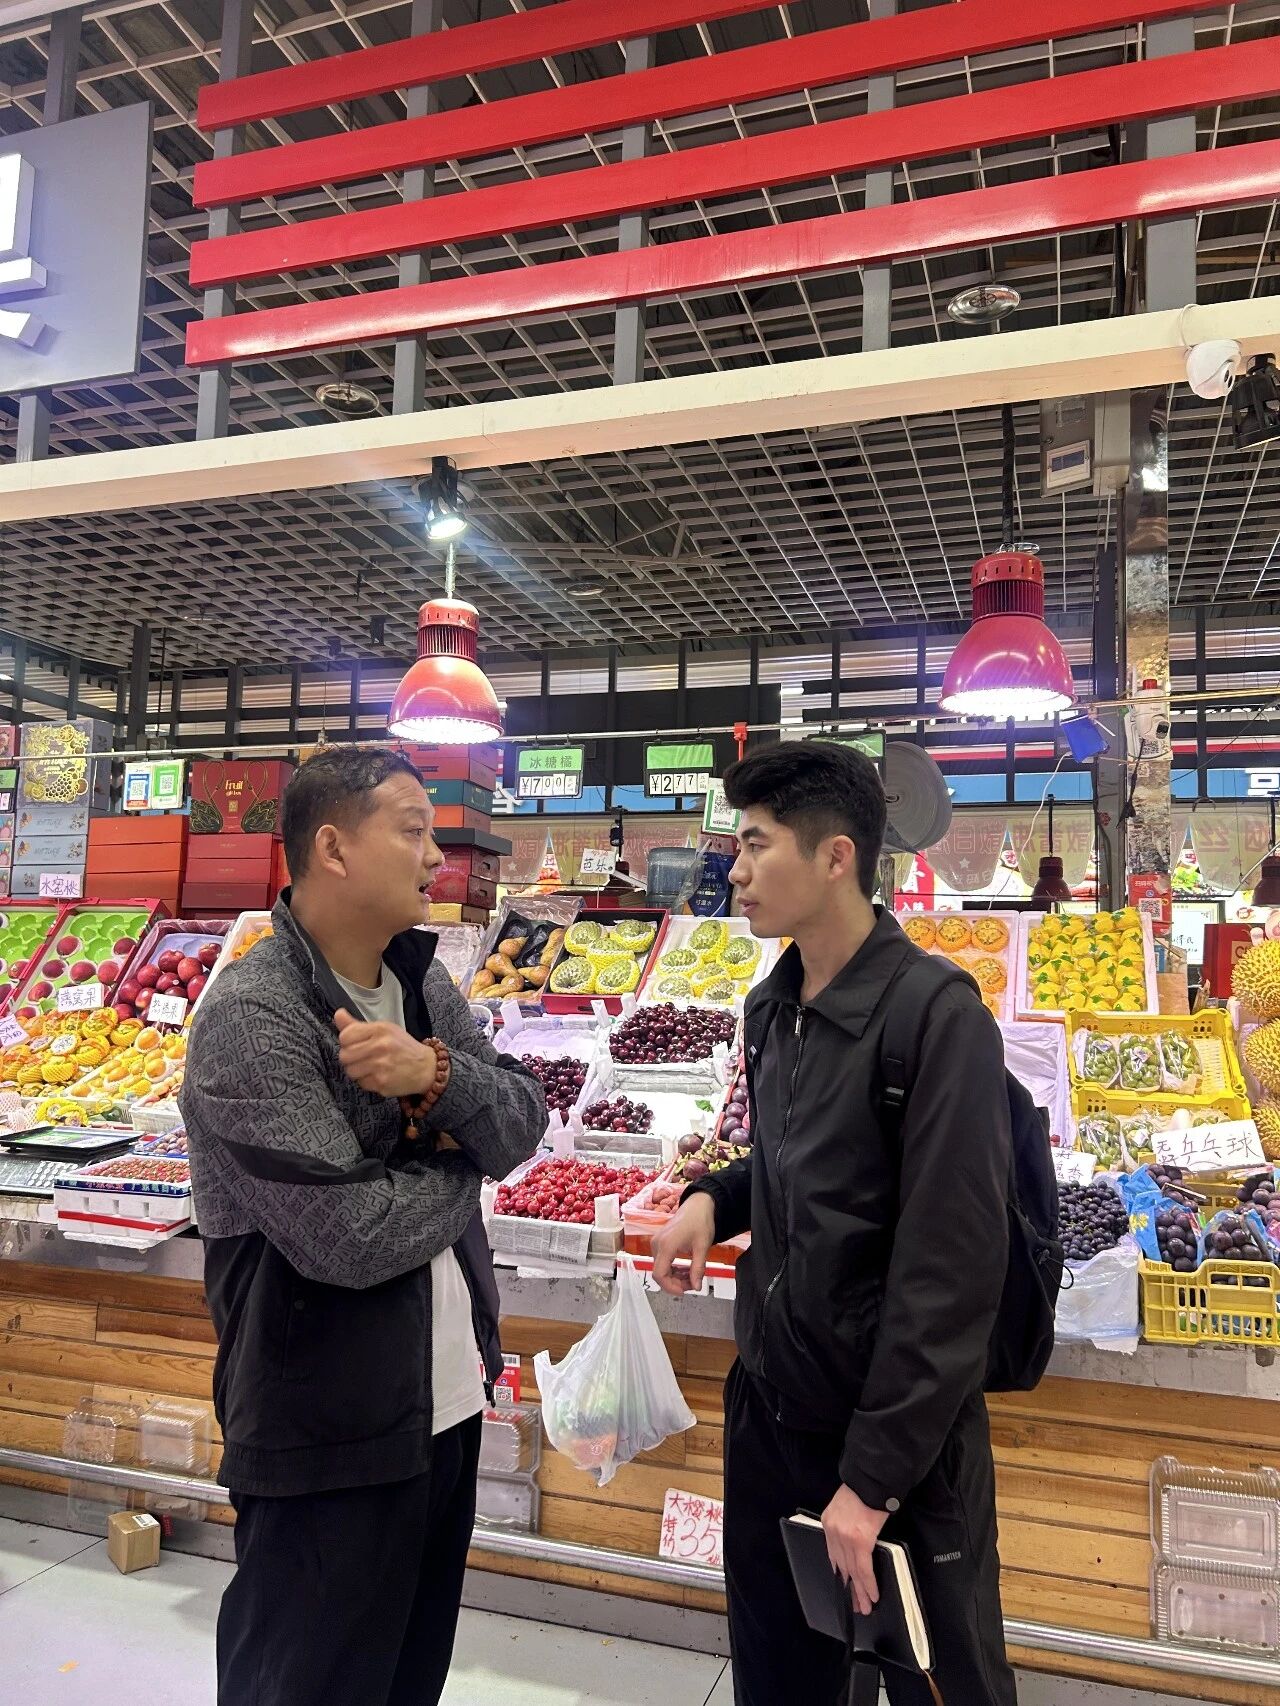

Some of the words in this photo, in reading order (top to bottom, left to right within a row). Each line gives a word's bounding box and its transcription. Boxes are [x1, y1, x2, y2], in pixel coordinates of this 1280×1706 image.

[530, 755, 572, 769] 冰糖橘
[679, 1517, 722, 1557] 35
